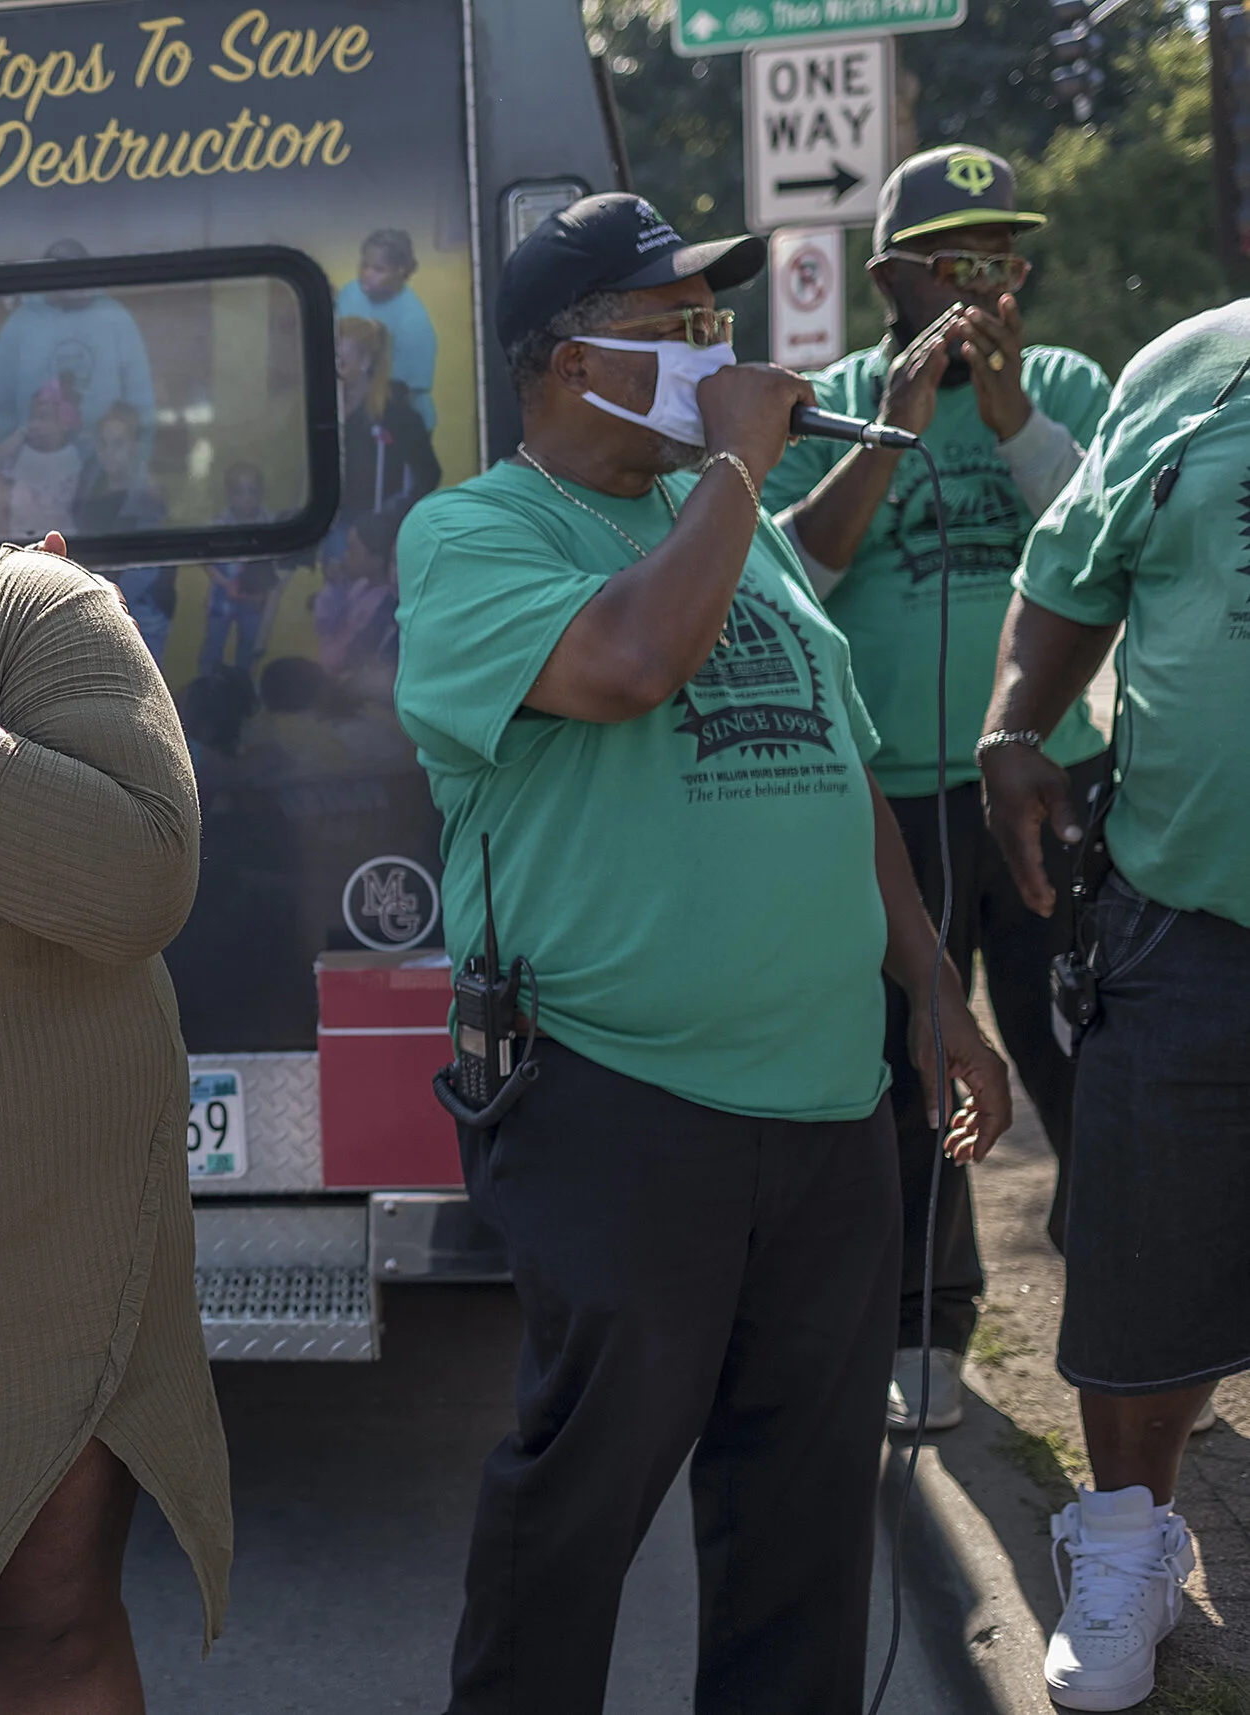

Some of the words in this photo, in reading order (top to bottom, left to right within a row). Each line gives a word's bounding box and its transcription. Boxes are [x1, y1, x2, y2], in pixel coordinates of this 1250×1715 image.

[137, 16, 195, 88] To
[209, 9, 375, 83] Save
[768, 52, 871, 103] ONE
[763, 103, 873, 153] WAY
[702, 710, 770, 746] SINCE
[772, 711, 821, 738] 1998
[685, 786, 713, 804] The
[718, 786, 751, 801] Force
[755, 780, 790, 797] behind
[793, 779, 811, 795] the
